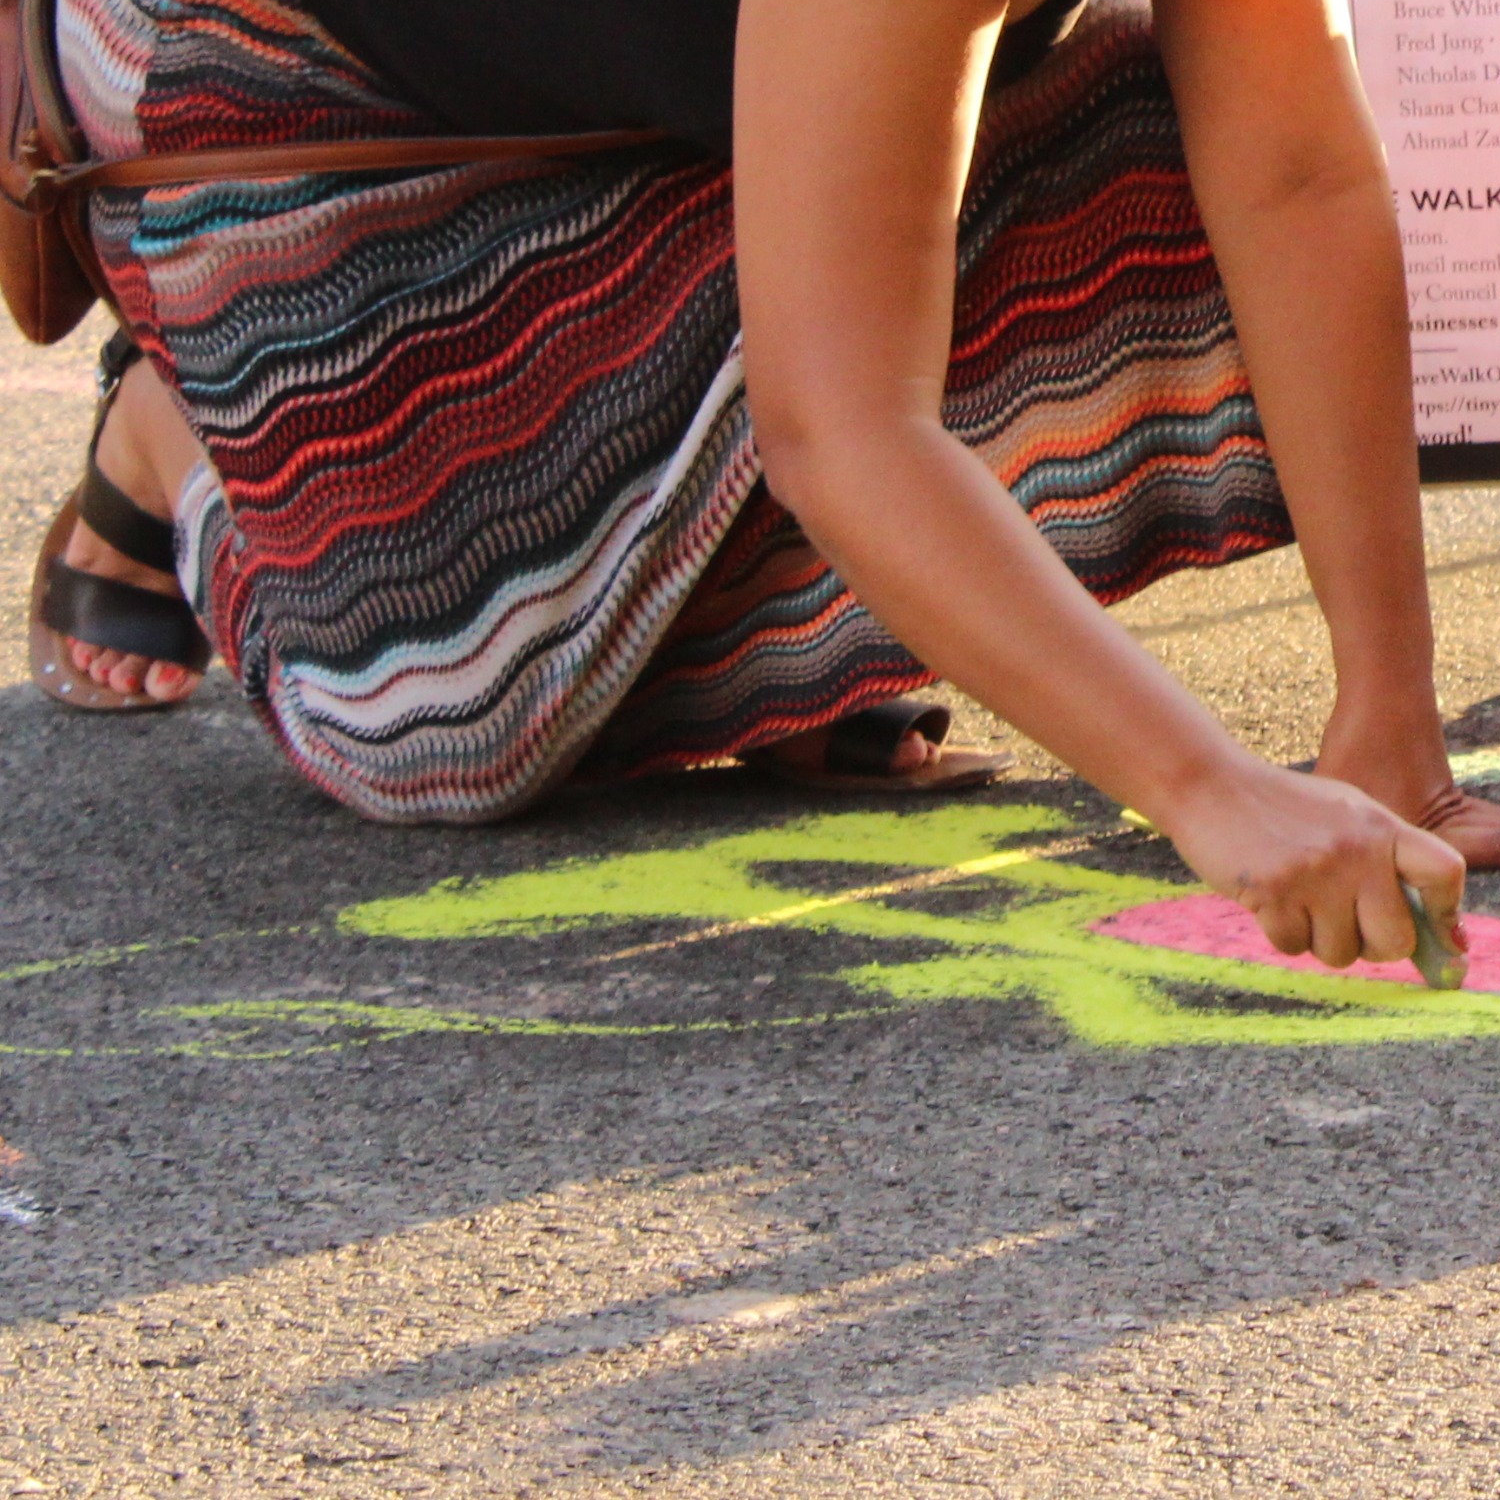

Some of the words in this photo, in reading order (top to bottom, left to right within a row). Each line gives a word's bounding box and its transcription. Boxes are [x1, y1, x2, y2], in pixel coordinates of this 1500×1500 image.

[1394, 0, 1444, 19] Bruce
[1396, 33, 1436, 51] Fred
[1441, 33, 1483, 55] Jung
[1398, 64, 1477, 85] Nicholas
[1400, 98, 1455, 118] Shana
[1403, 130, 1468, 150] Ahmad
[1426, 282, 1497, 302] Council
